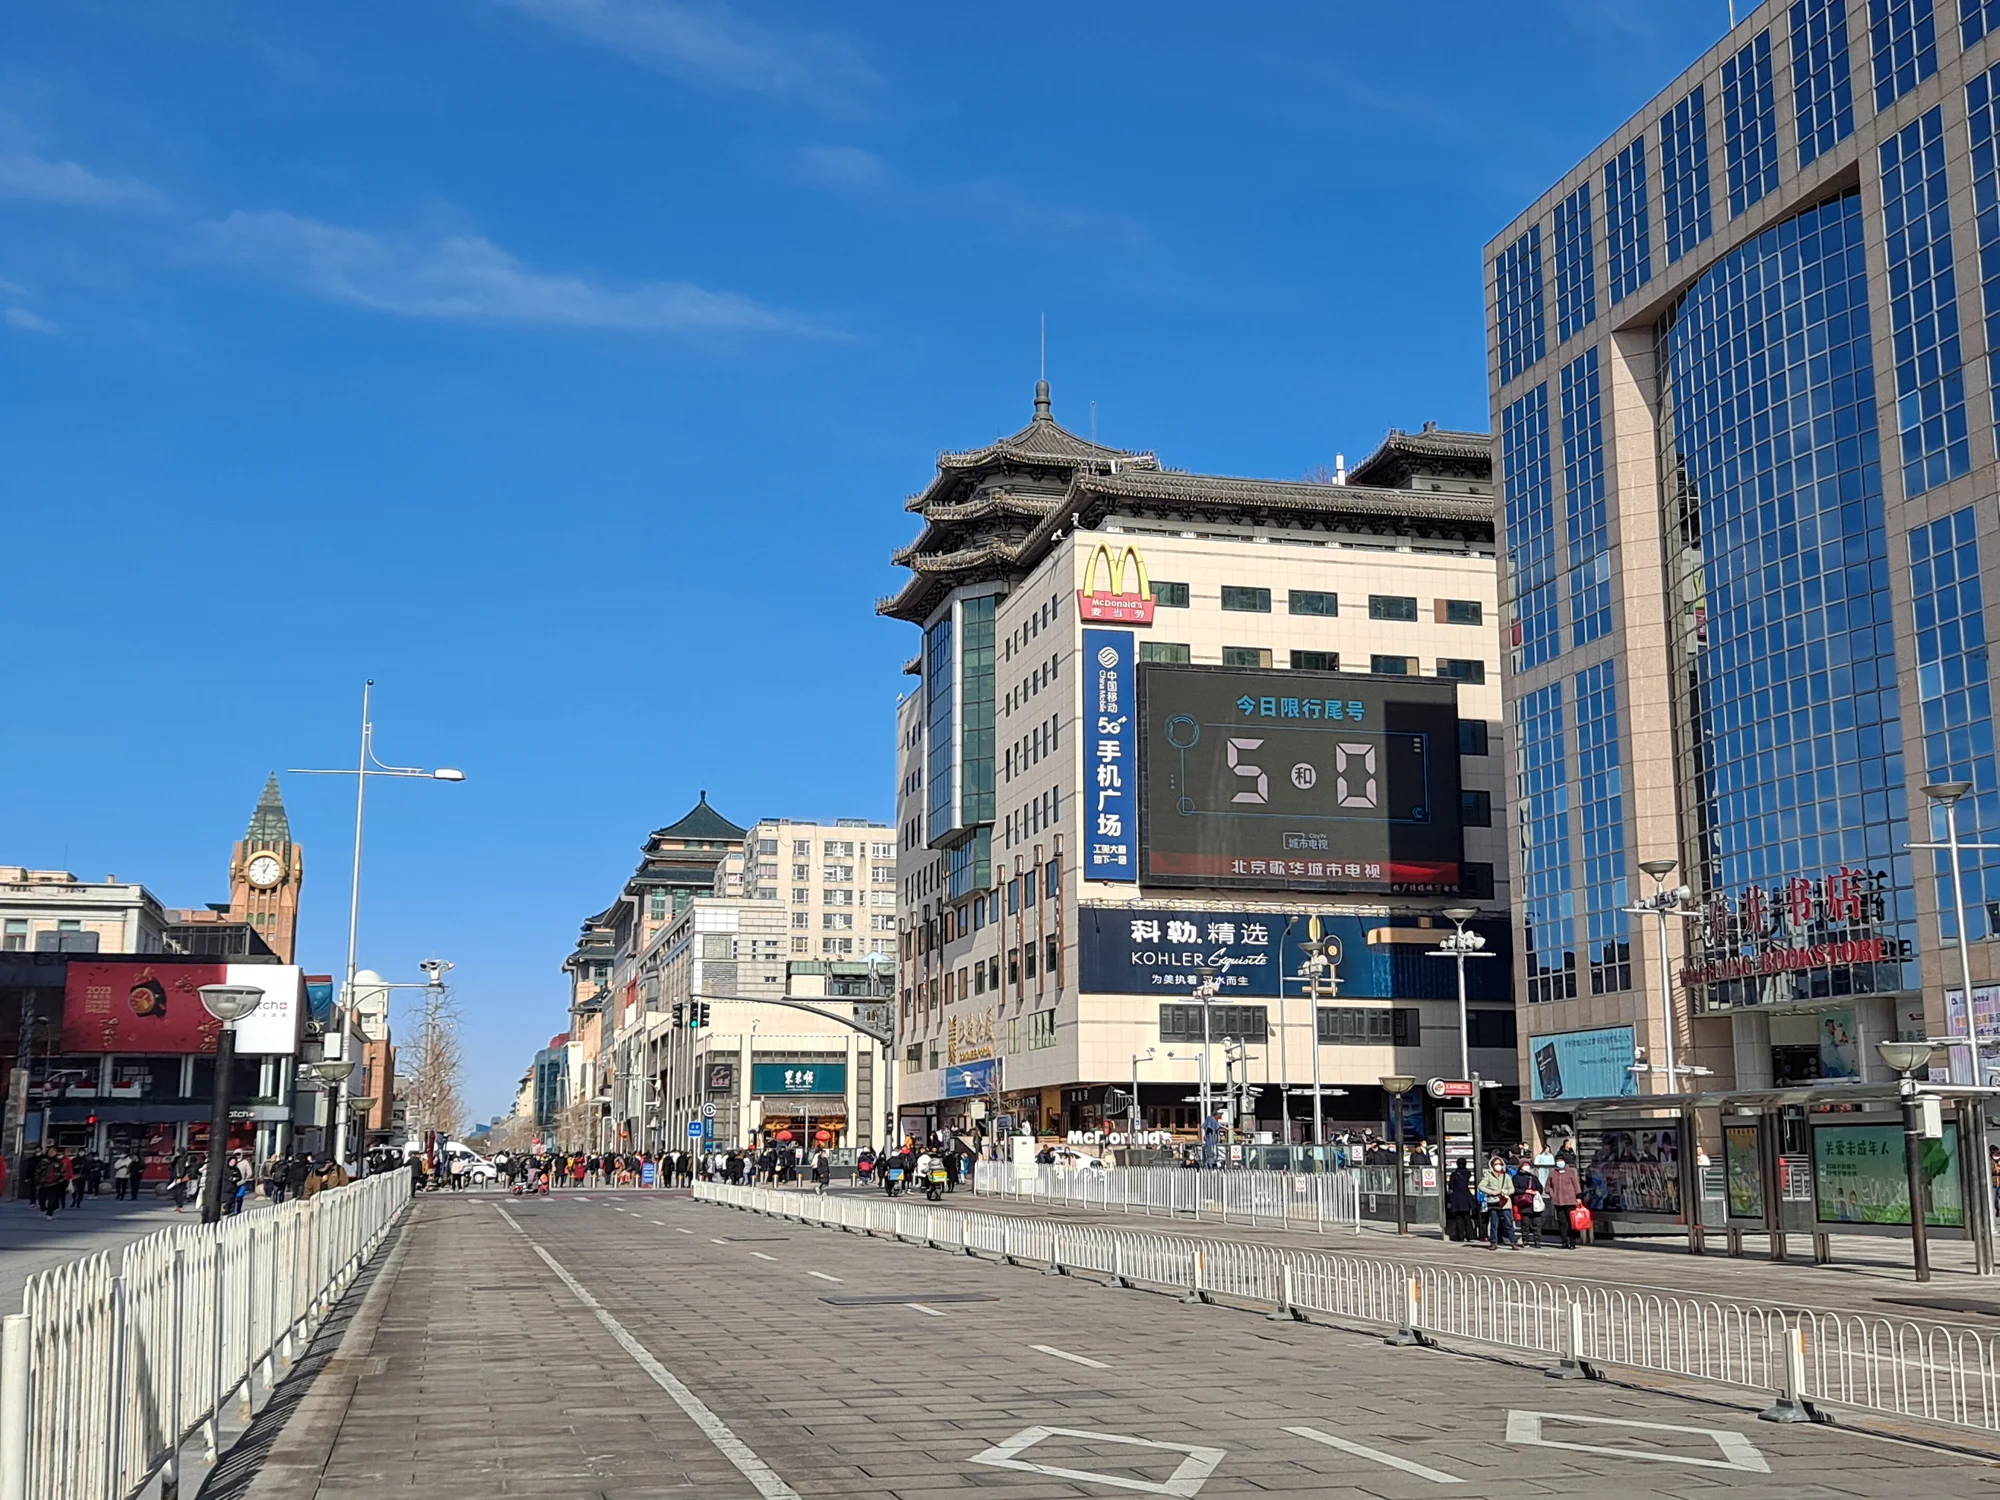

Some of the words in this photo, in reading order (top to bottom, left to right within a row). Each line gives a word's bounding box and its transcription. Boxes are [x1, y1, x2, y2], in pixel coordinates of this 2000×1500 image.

[1091, 599, 1143, 609] McDonald's
[1107, 670, 1118, 713] 中国移动
[1236, 694, 1365, 721] 今日限行尾号
[1227, 737, 1269, 804] 5
[1293, 765, 1314, 787] 和
[1336, 742, 1377, 809] 0
[1096, 740, 1122, 837] 手机广场
[1288, 838, 1329, 850] 城市电视
[1231, 859, 1381, 879] 北京歌华城市电视
[1131, 951, 1205, 966] KOHLER
[1207, 947, 1270, 973] Exquisite
[1760, 937, 1888, 974] BOOKSTORE
[87, 986, 112, 995] 2023
[1151, 973, 1198, 985] 为美执着
